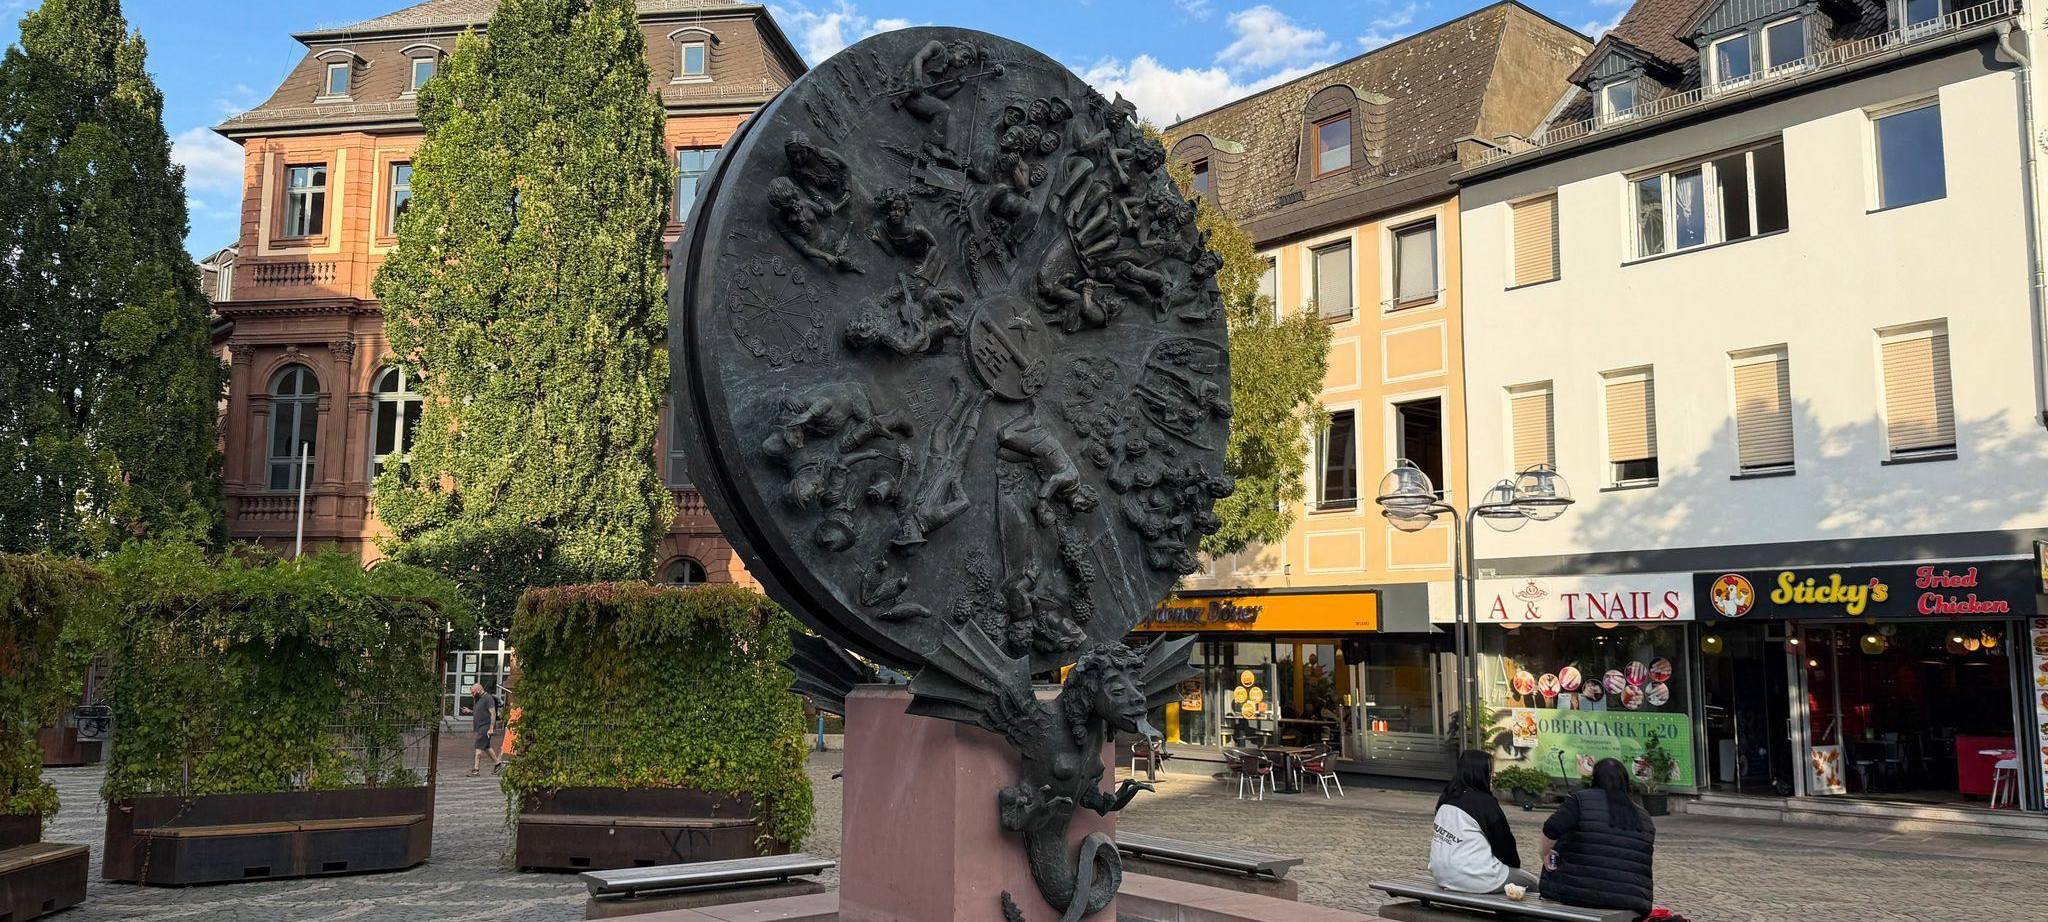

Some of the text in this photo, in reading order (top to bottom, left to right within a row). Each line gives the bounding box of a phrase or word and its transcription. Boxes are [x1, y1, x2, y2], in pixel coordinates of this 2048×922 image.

[1915, 566, 1977, 588] Fried
[1770, 571, 1888, 615] Sticky's
[1917, 592, 2010, 614] Chicken
[1488, 594, 1509, 619] A
[1525, 601, 1542, 620] &
[1586, 591, 1680, 620] NAILS
[1538, 719, 1679, 739] OBERMARKT 20
